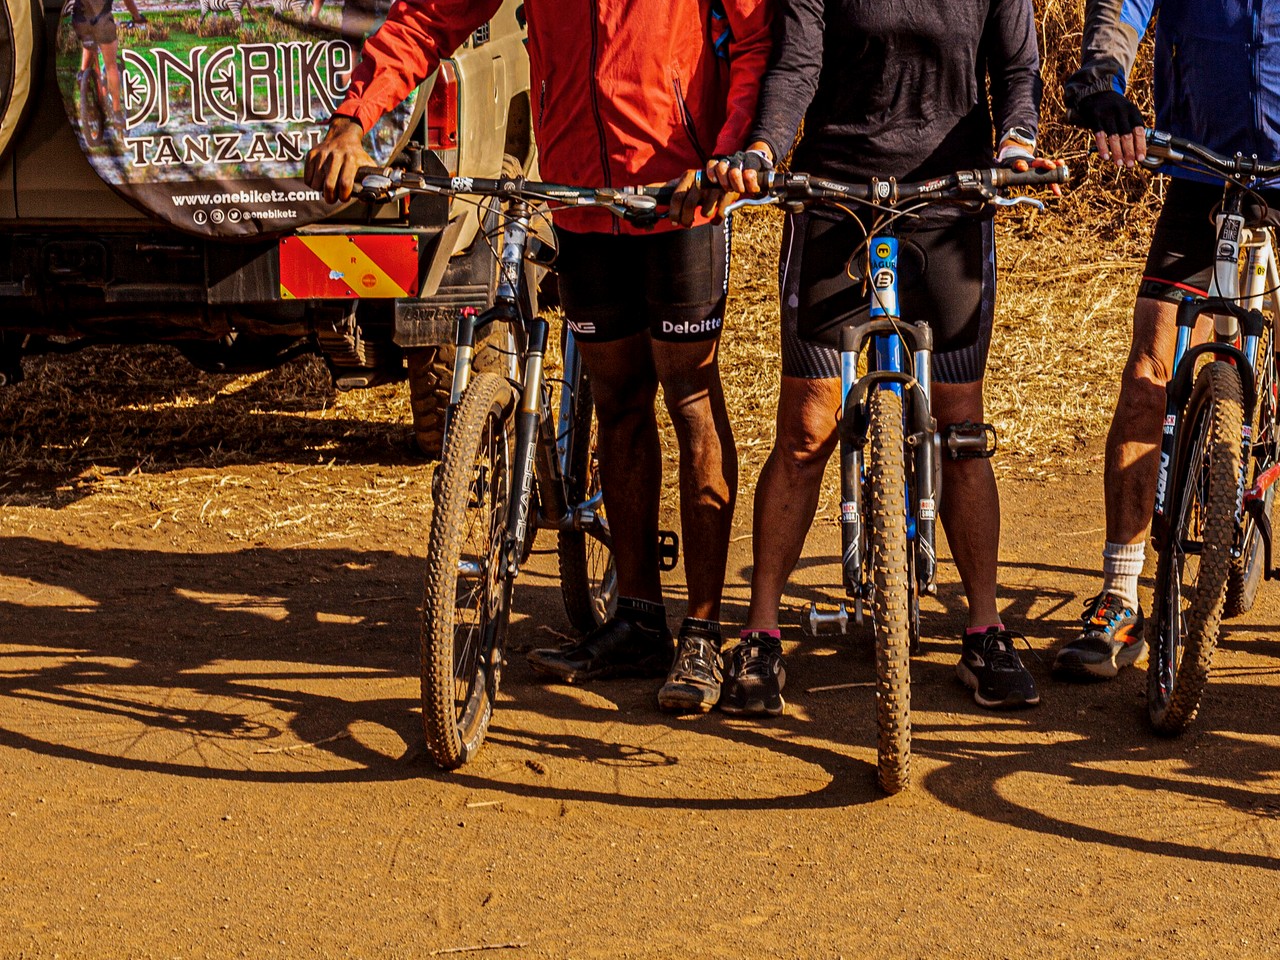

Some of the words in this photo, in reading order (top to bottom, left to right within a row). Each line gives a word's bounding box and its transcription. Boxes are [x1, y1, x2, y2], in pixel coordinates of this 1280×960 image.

[124, 130, 323, 168] TANZANI
[171, 189, 320, 207] www.onebiketz.com
[242, 208, 297, 220] @onebiketz
[662, 317, 722, 334] Deloitte
